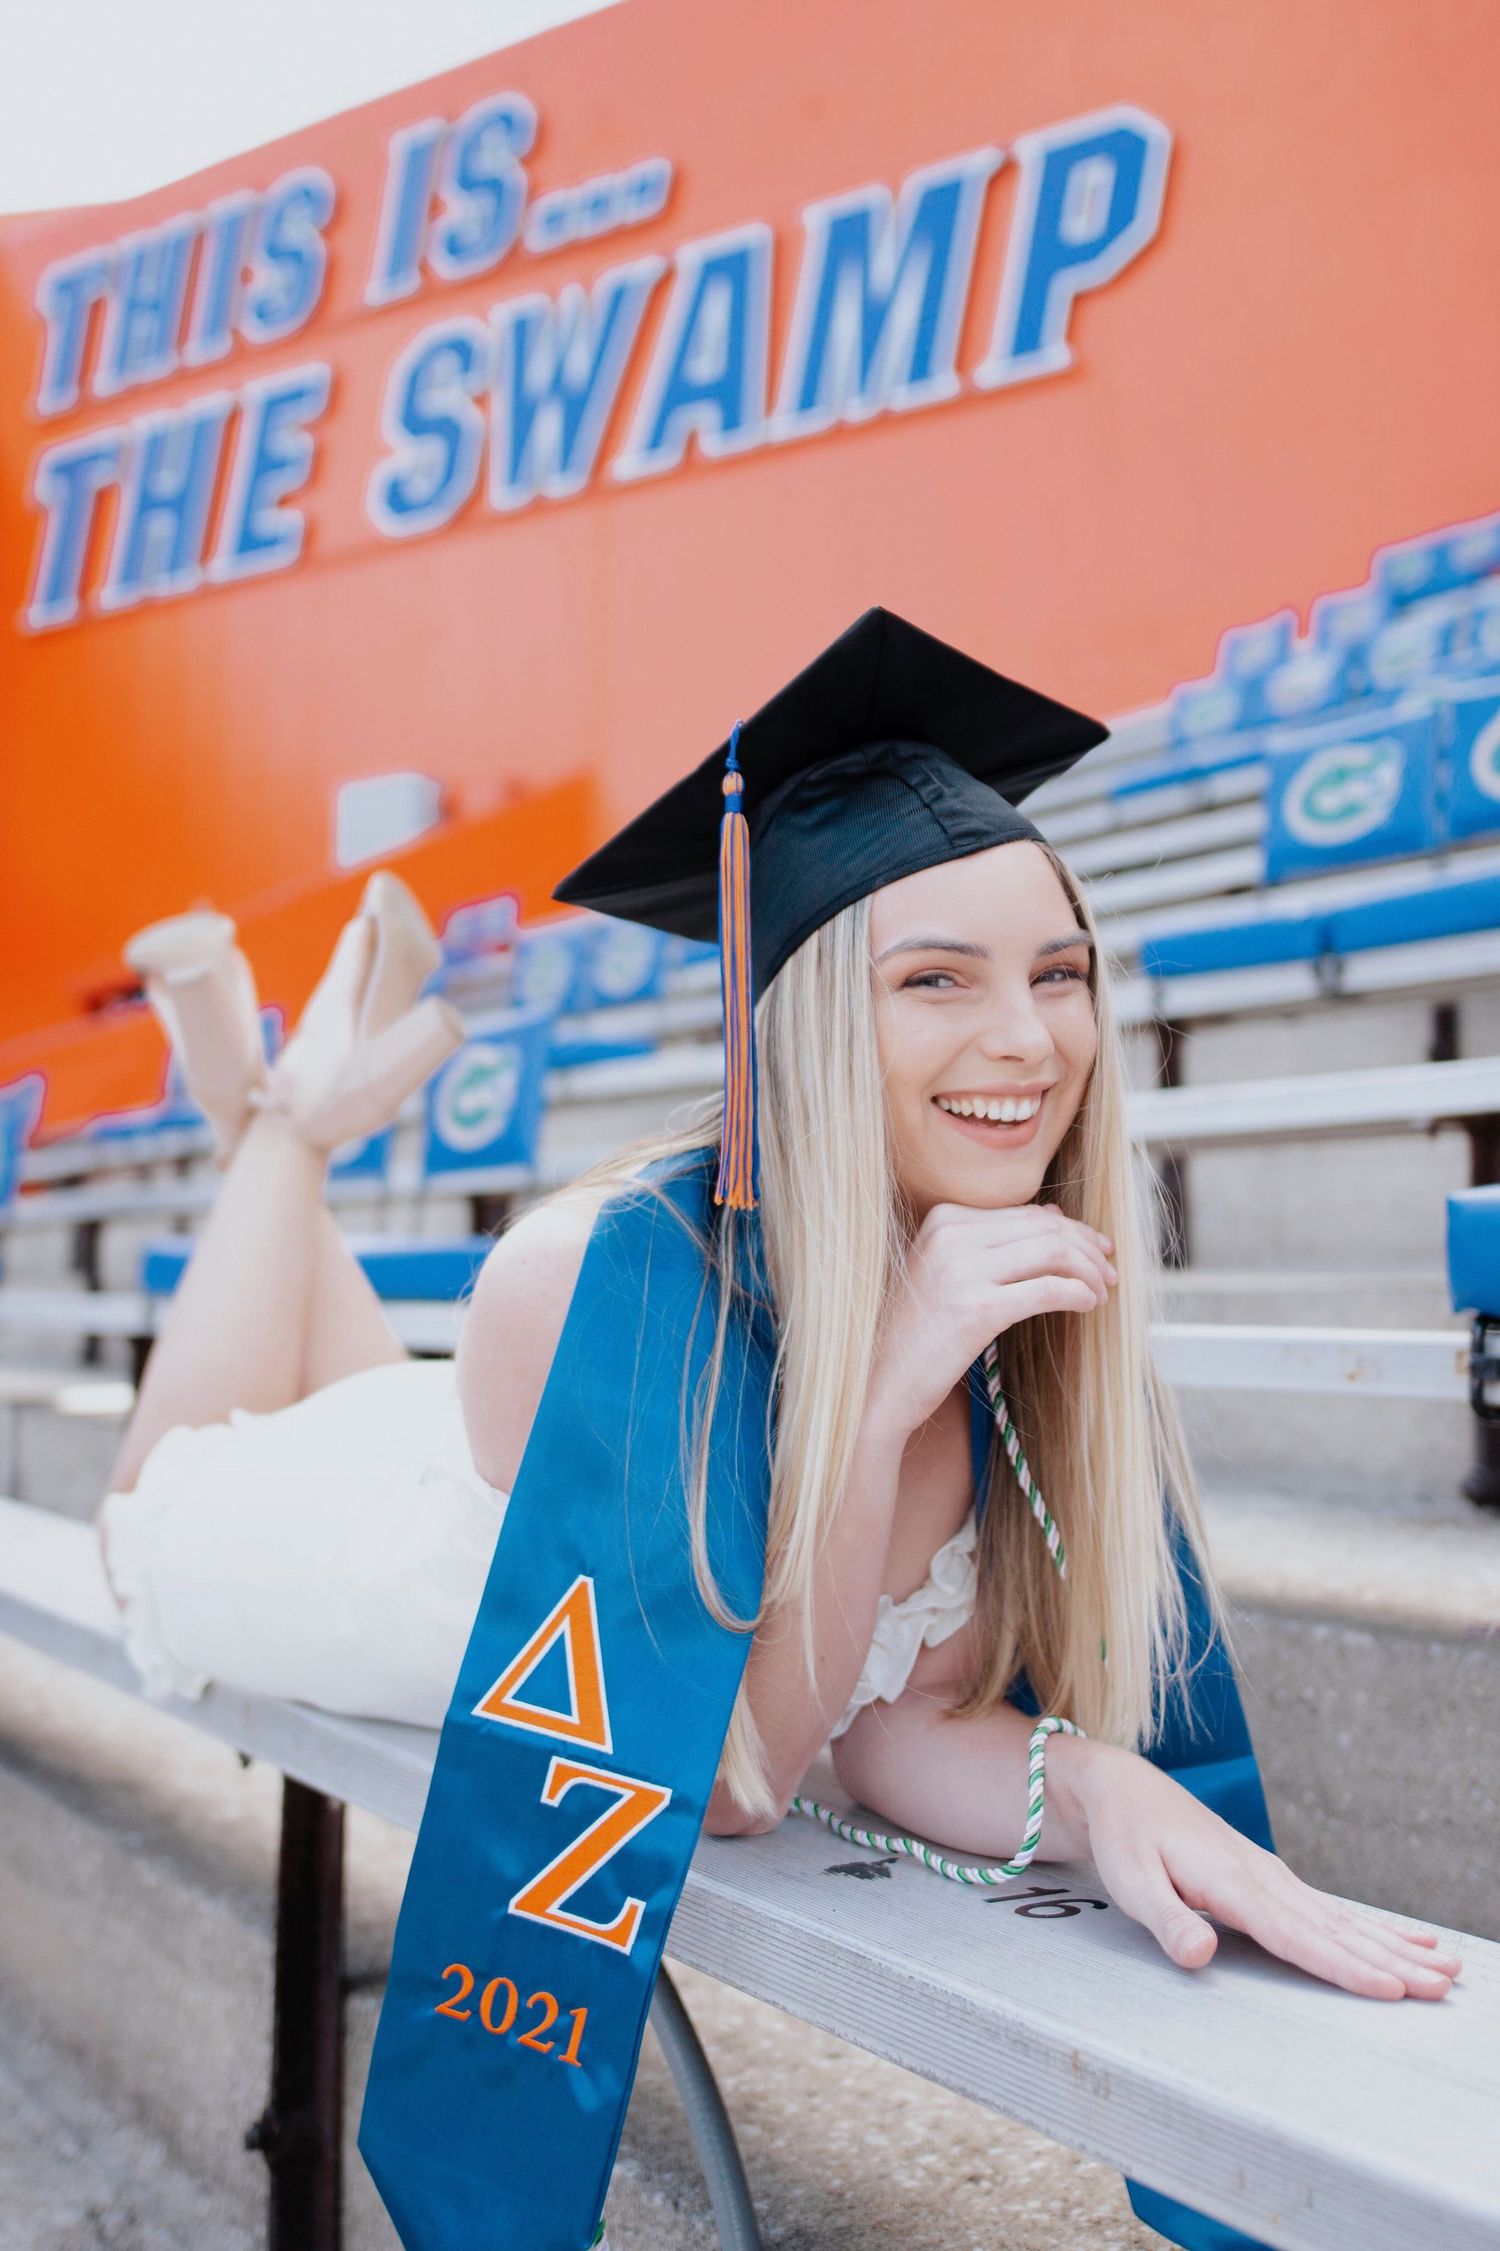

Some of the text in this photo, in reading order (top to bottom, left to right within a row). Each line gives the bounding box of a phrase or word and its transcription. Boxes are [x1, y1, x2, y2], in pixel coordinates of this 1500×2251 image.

[26, 104, 1173, 631] THE SWAMP
[36, 165, 337, 417] THIS
[982, 1886, 1109, 1919] 16
[434, 1963, 590, 2069] 2021
